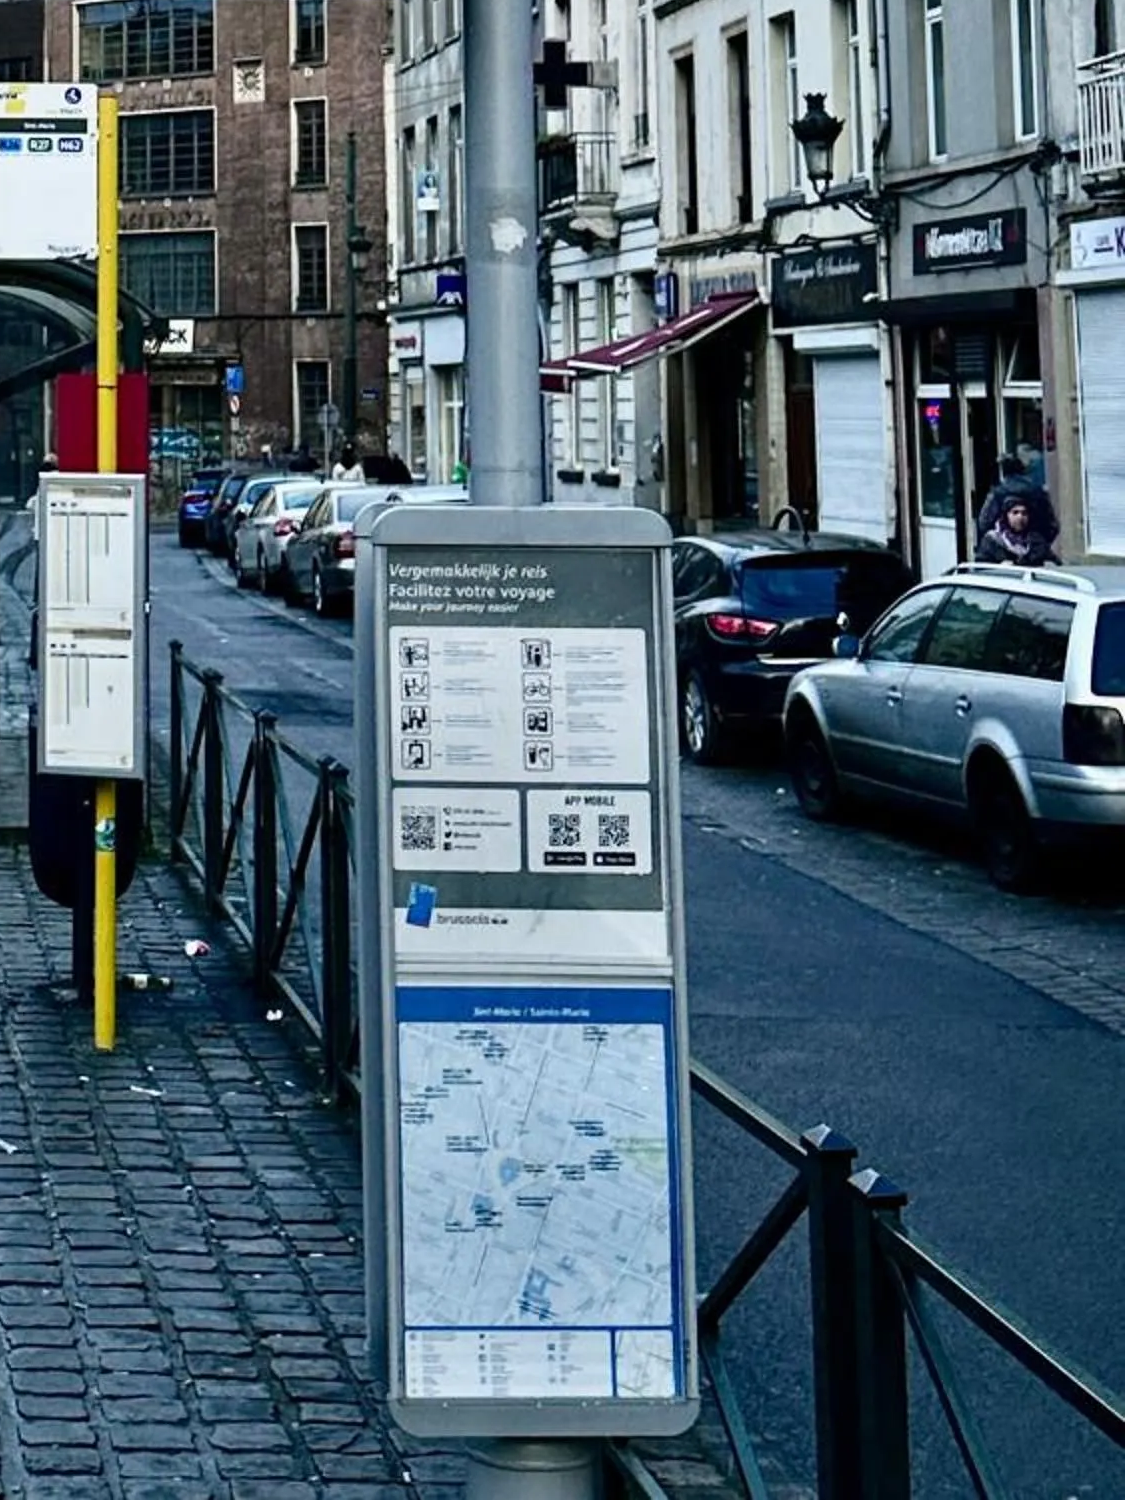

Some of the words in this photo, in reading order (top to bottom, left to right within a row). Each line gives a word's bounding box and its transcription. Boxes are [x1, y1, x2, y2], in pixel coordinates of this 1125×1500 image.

[389, 563, 500, 580] Vergemakkelijk
[501, 564, 517, 580] je
[521, 565, 548, 579] reis
[389, 583, 452, 598] Facilitez
[455, 585, 496, 599] votre
[500, 587, 556, 602] voyage
